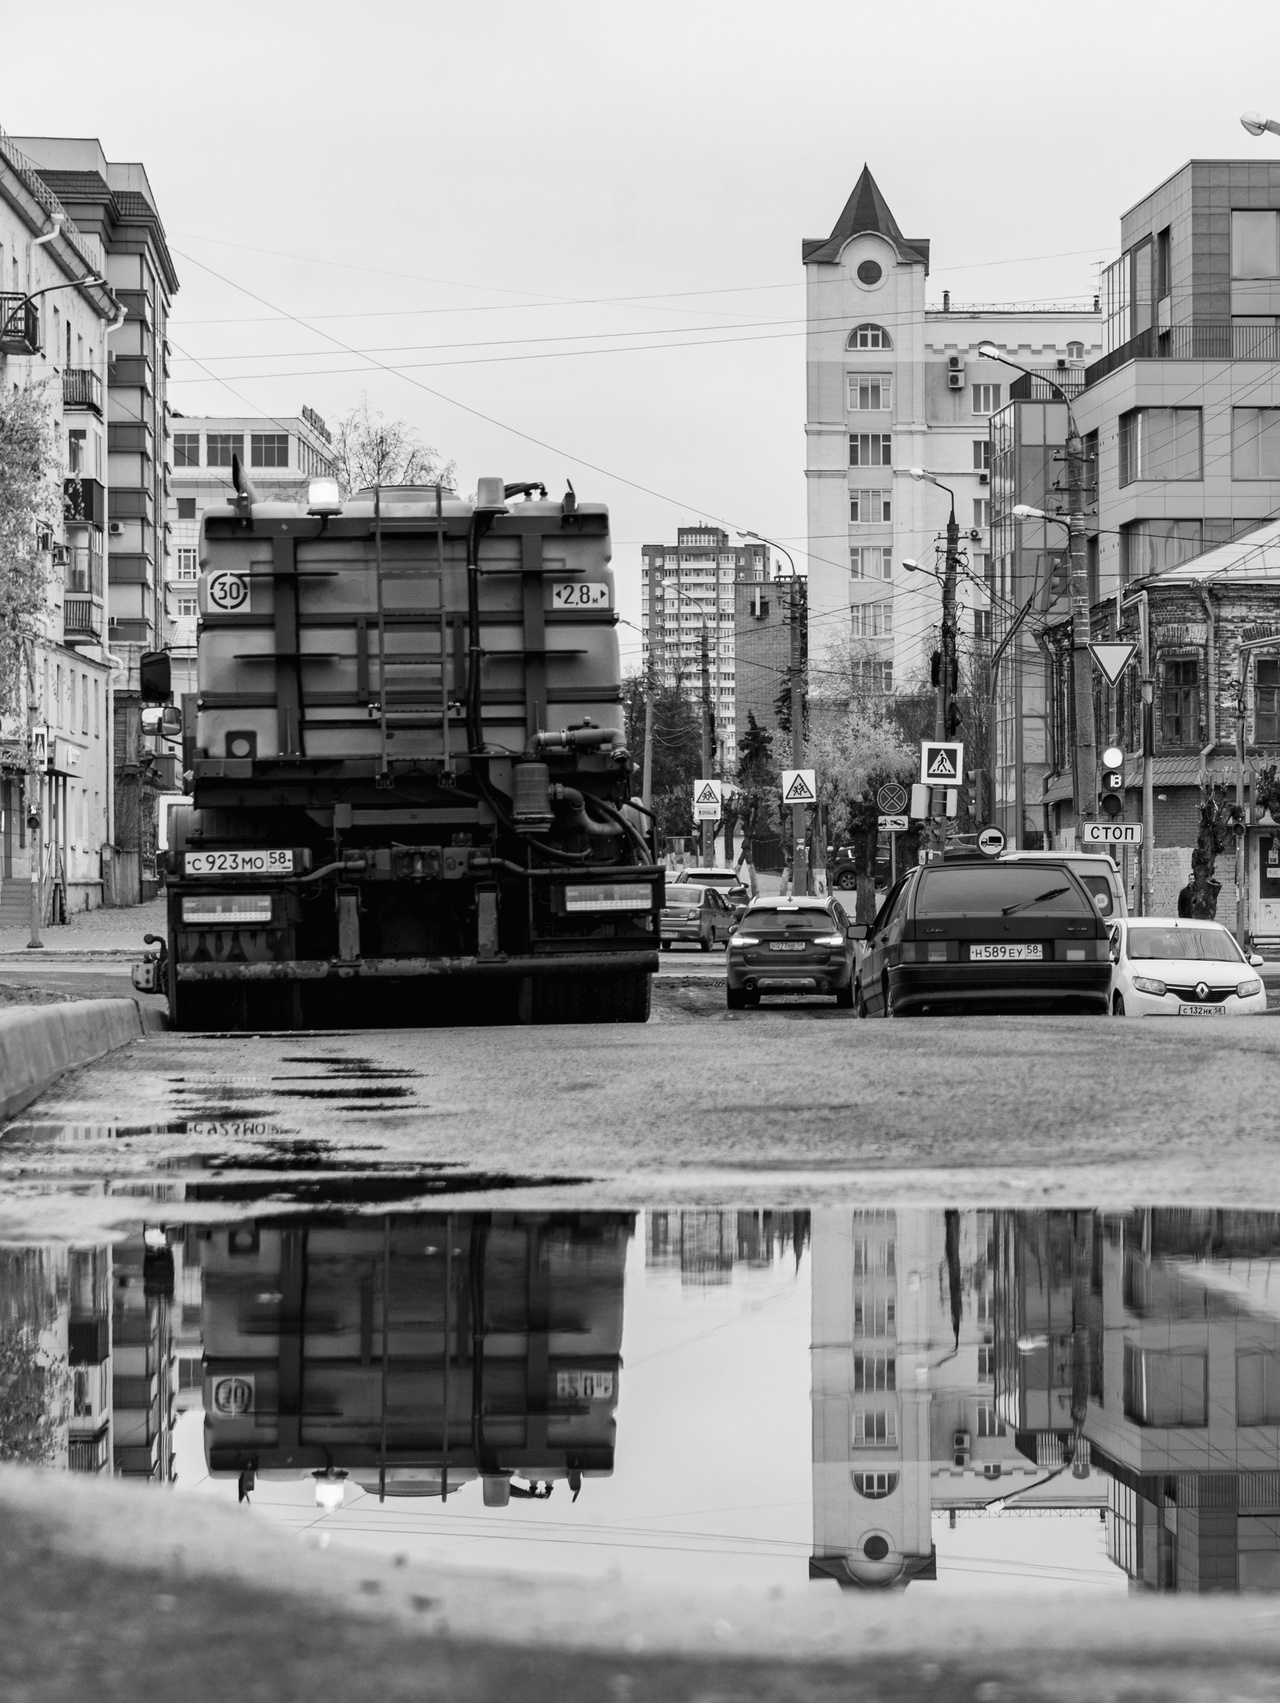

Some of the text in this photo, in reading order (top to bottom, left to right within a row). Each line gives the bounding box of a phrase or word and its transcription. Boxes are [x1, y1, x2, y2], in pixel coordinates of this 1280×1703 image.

[218, 582, 240, 600] 30
[563, 585, 590, 606] 2,8
[1090, 826, 1135, 841] СТОП
